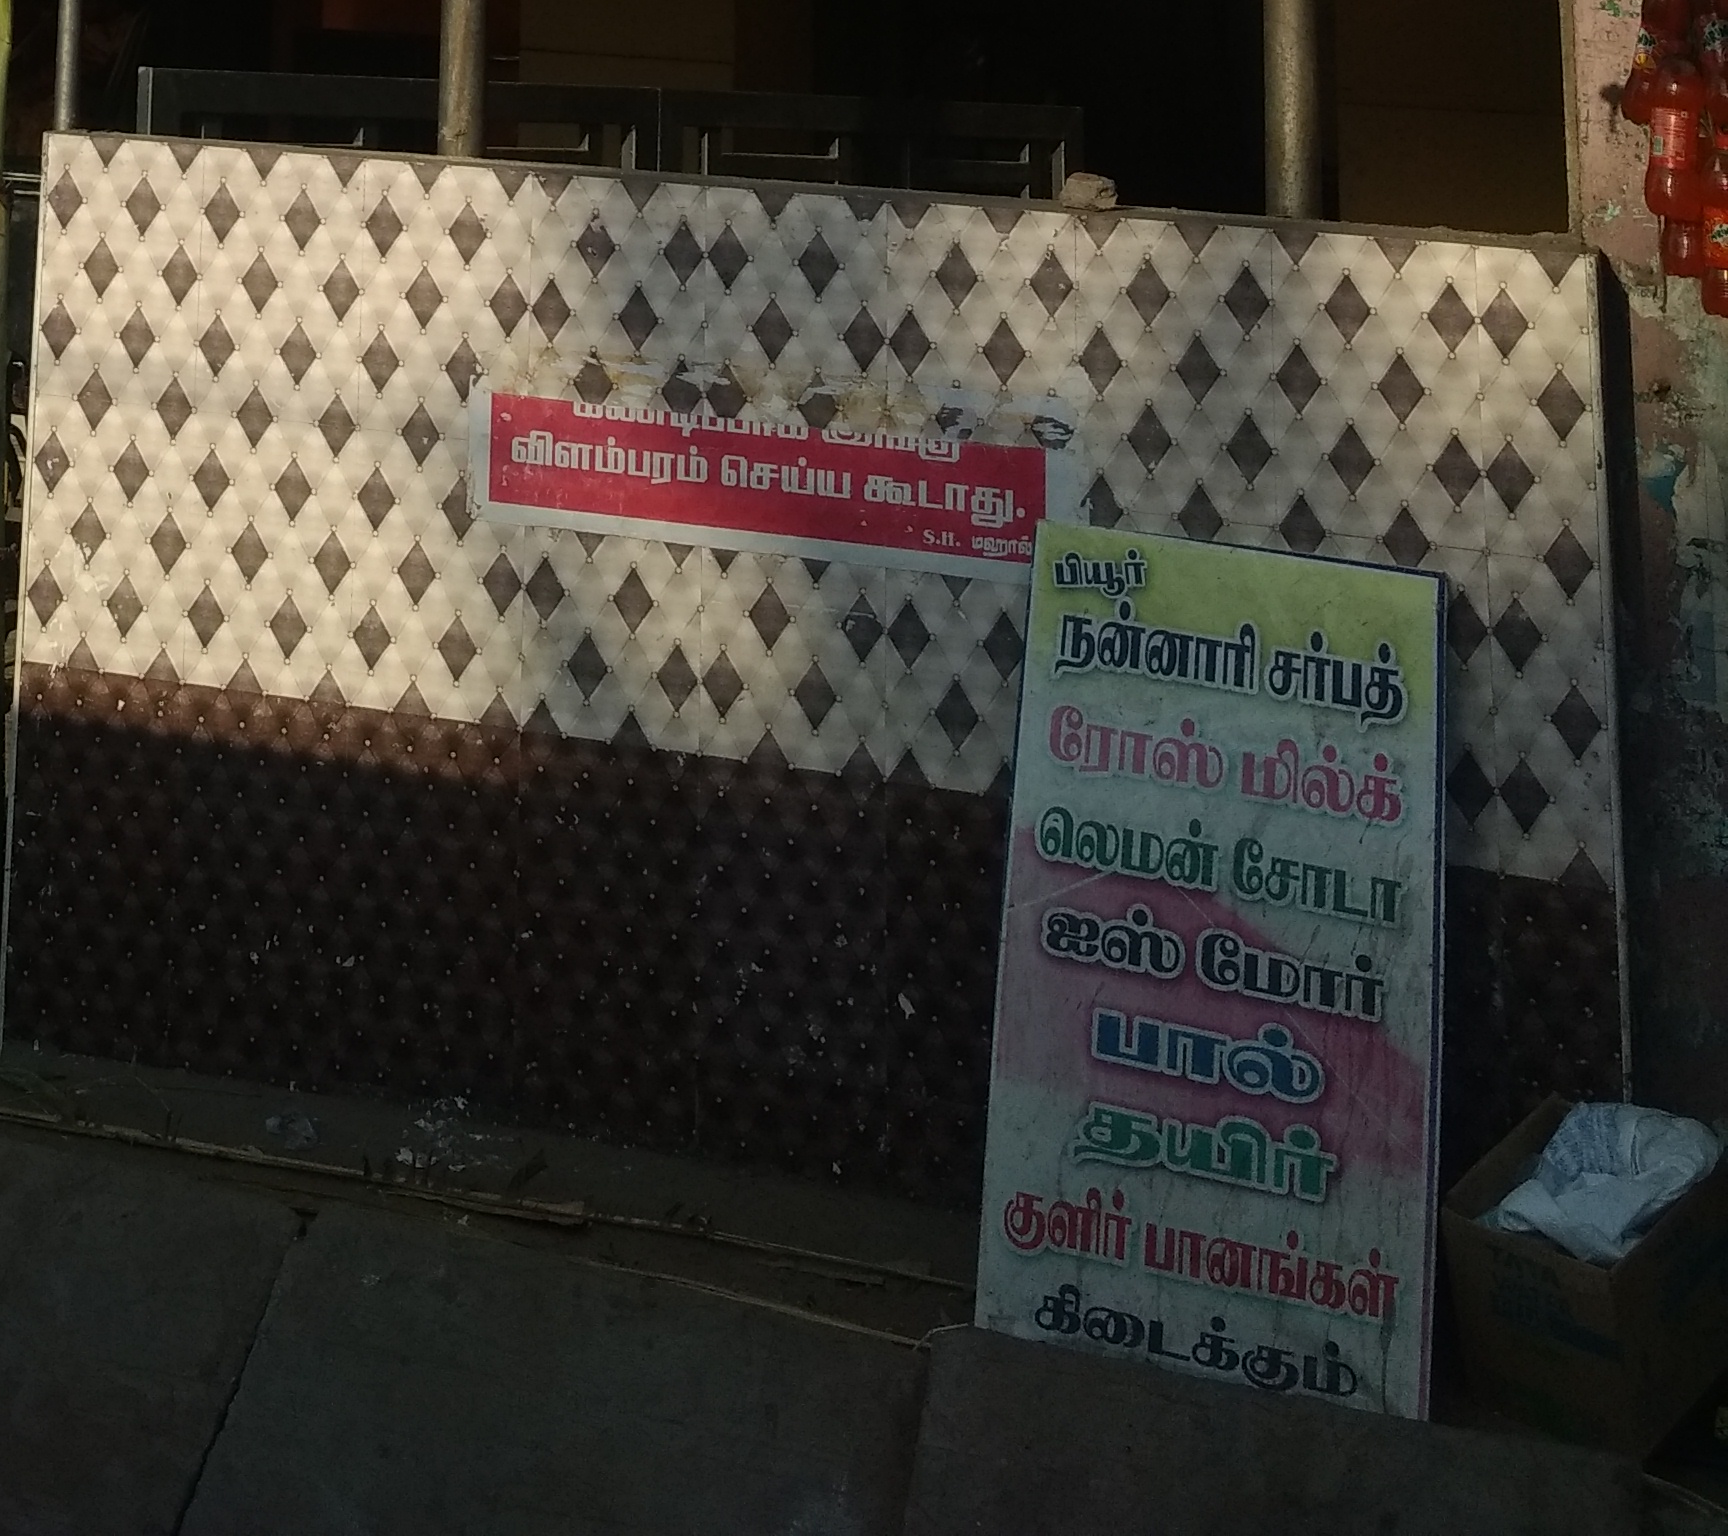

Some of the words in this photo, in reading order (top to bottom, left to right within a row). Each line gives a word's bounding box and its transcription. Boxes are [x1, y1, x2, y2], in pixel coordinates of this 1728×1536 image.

[511, 430, 707, 484] விளம்பரம்
[721, 456, 851, 499] செய்ய
[864, 474, 1026, 528] கூடாது.
[923, 530, 961, 547] S.H.
[1054, 549, 1145, 594] பியூர்
[1056, 601, 1255, 690] நன்னாரி
[1269, 632, 1403, 724] சர்பத்
[1050, 707, 1222, 787] ரோஸ்
[1242, 739, 1401, 821] மில்க்
[1039, 809, 1218, 886] லெமன்
[1233, 838, 1401, 922] சோடா
[1047, 909, 1178, 974] ஐஸ்
[1202, 933, 1383, 1017] மோர்
[1098, 1013, 1320, 1097] பால்
[1076, 1107, 1334, 1199] தயிர்
[1004, 1188, 1131, 1259] குளிர்
[1144, 1223, 1399, 1318] பானங்கள்
[1035, 1284, 1357, 1397] கிடைக்கும்
